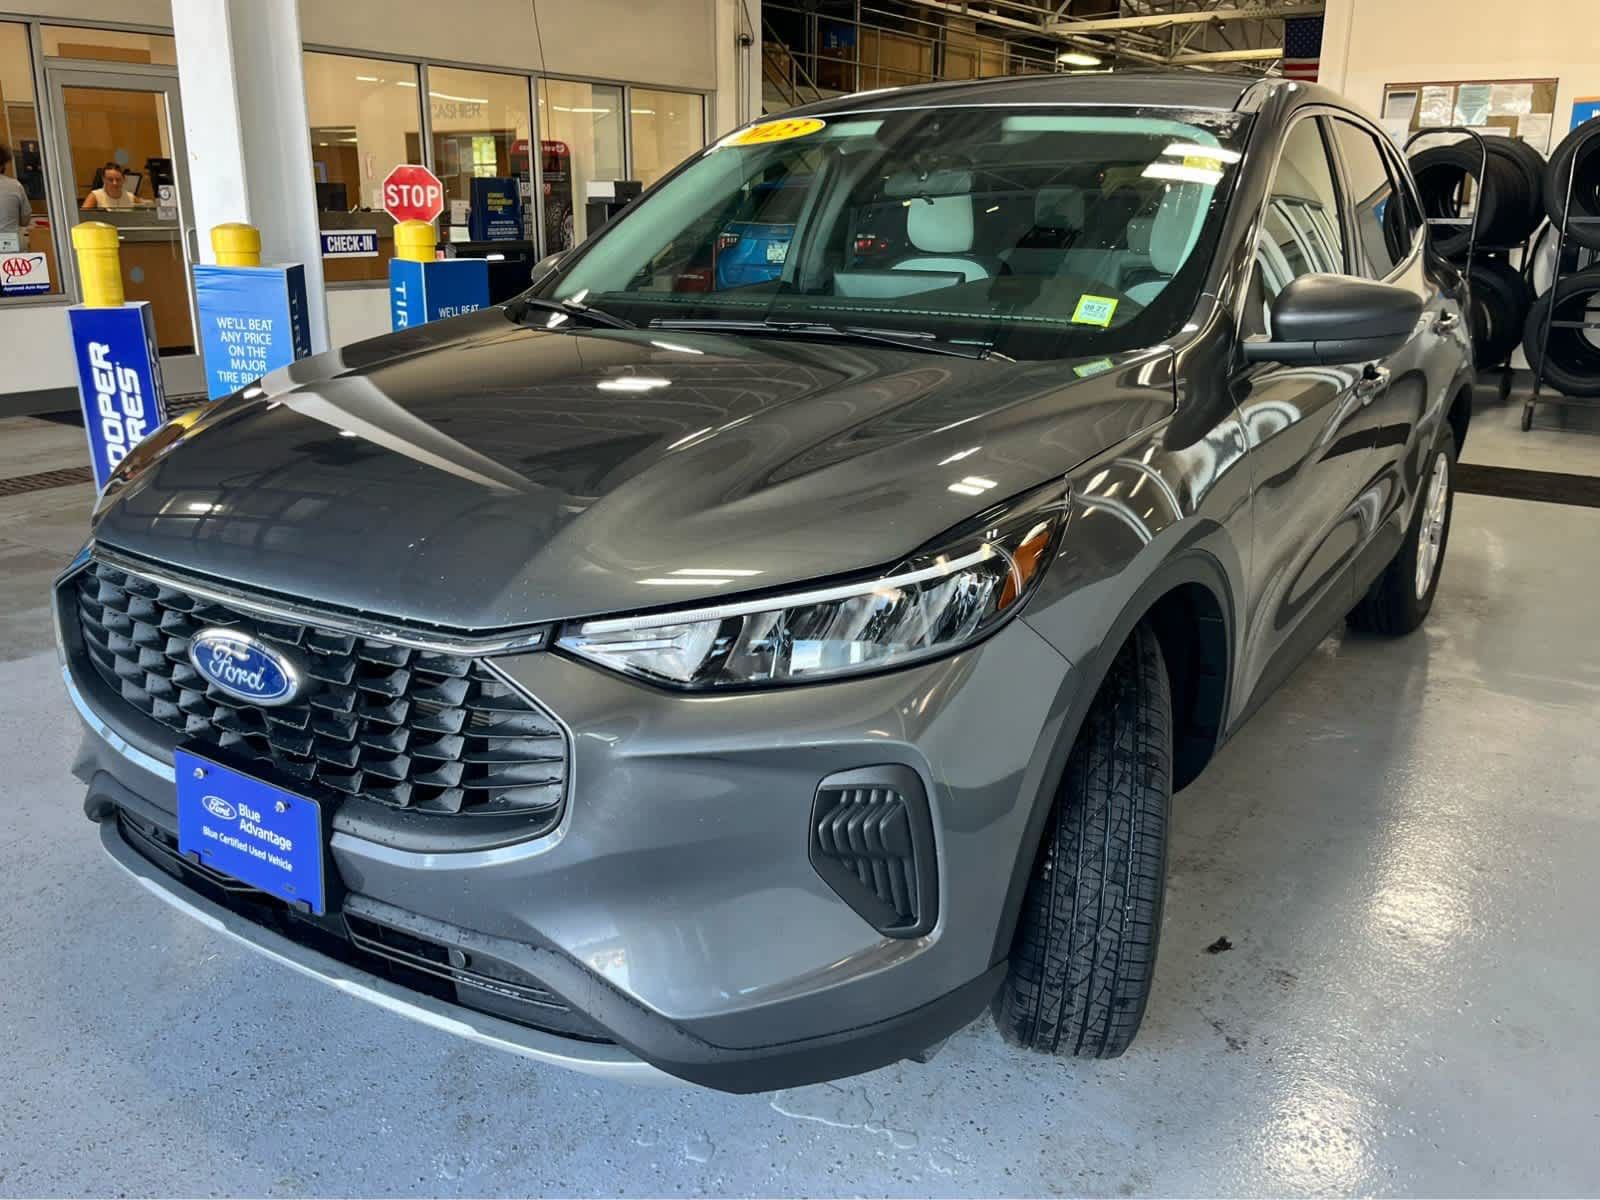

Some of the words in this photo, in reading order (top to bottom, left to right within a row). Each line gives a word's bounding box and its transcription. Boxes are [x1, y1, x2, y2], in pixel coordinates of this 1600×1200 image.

[386, 184, 439, 208] STOP
[326, 234, 374, 253] CHECK-IN
[4, 258, 31, 276] AAA
[216, 317, 247, 330] WE'LL
[248, 319, 273, 331] BEAT
[220, 332, 242, 344] ANY
[244, 333, 272, 345] PRICE
[228, 345, 245, 357] ON
[247, 346, 267, 358] THE
[231, 359, 267, 372] MAJOR
[216, 370, 239, 383] TIRE
[88, 341, 128, 473] OOPER
[208, 644, 265, 691] Ford
[208, 798, 231, 818] Ford
[238, 803, 261, 823] Blue
[239, 818, 292, 851] Advantage
[202, 825, 219, 841] Blue
[219, 832, 248, 852] Certified
[249, 845, 267, 861] Used
[268, 852, 293, 873] Vehicle
